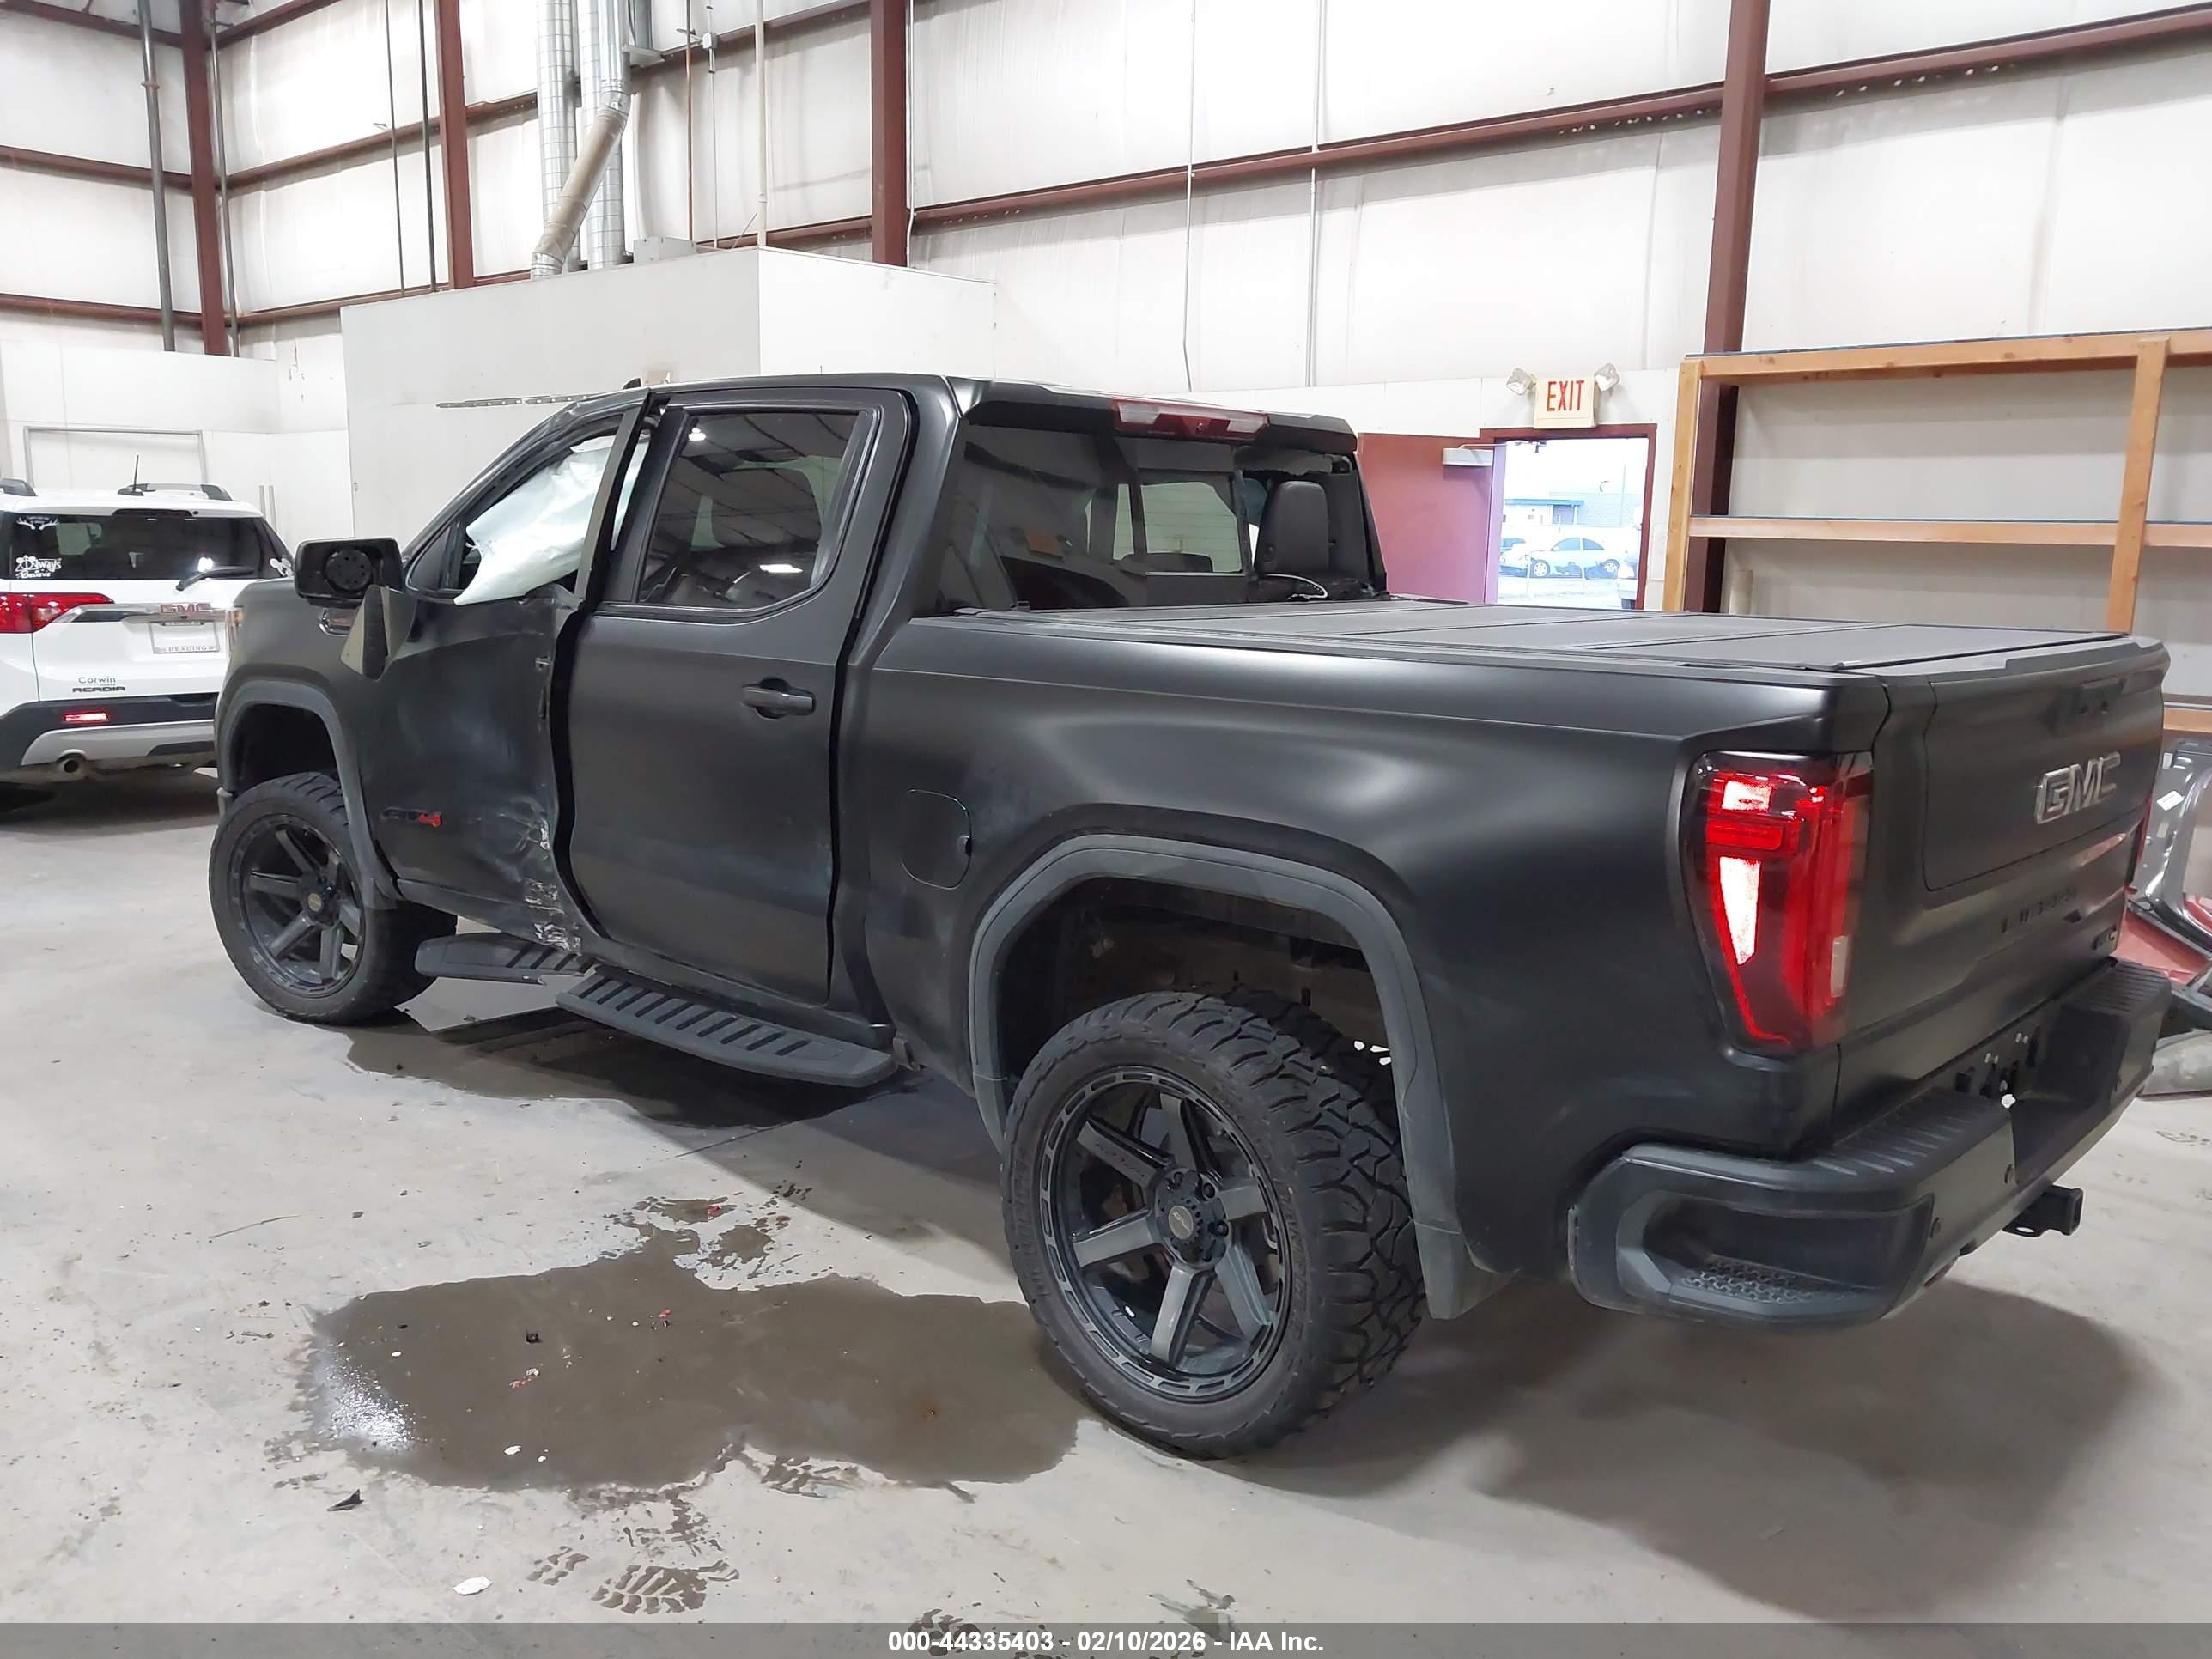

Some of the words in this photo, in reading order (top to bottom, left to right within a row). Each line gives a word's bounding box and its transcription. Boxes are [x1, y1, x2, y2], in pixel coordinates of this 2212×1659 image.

[1547, 380, 1584, 411] EXIT
[160, 603, 213, 613] GMC
[2034, 751, 2121, 824] GMC
